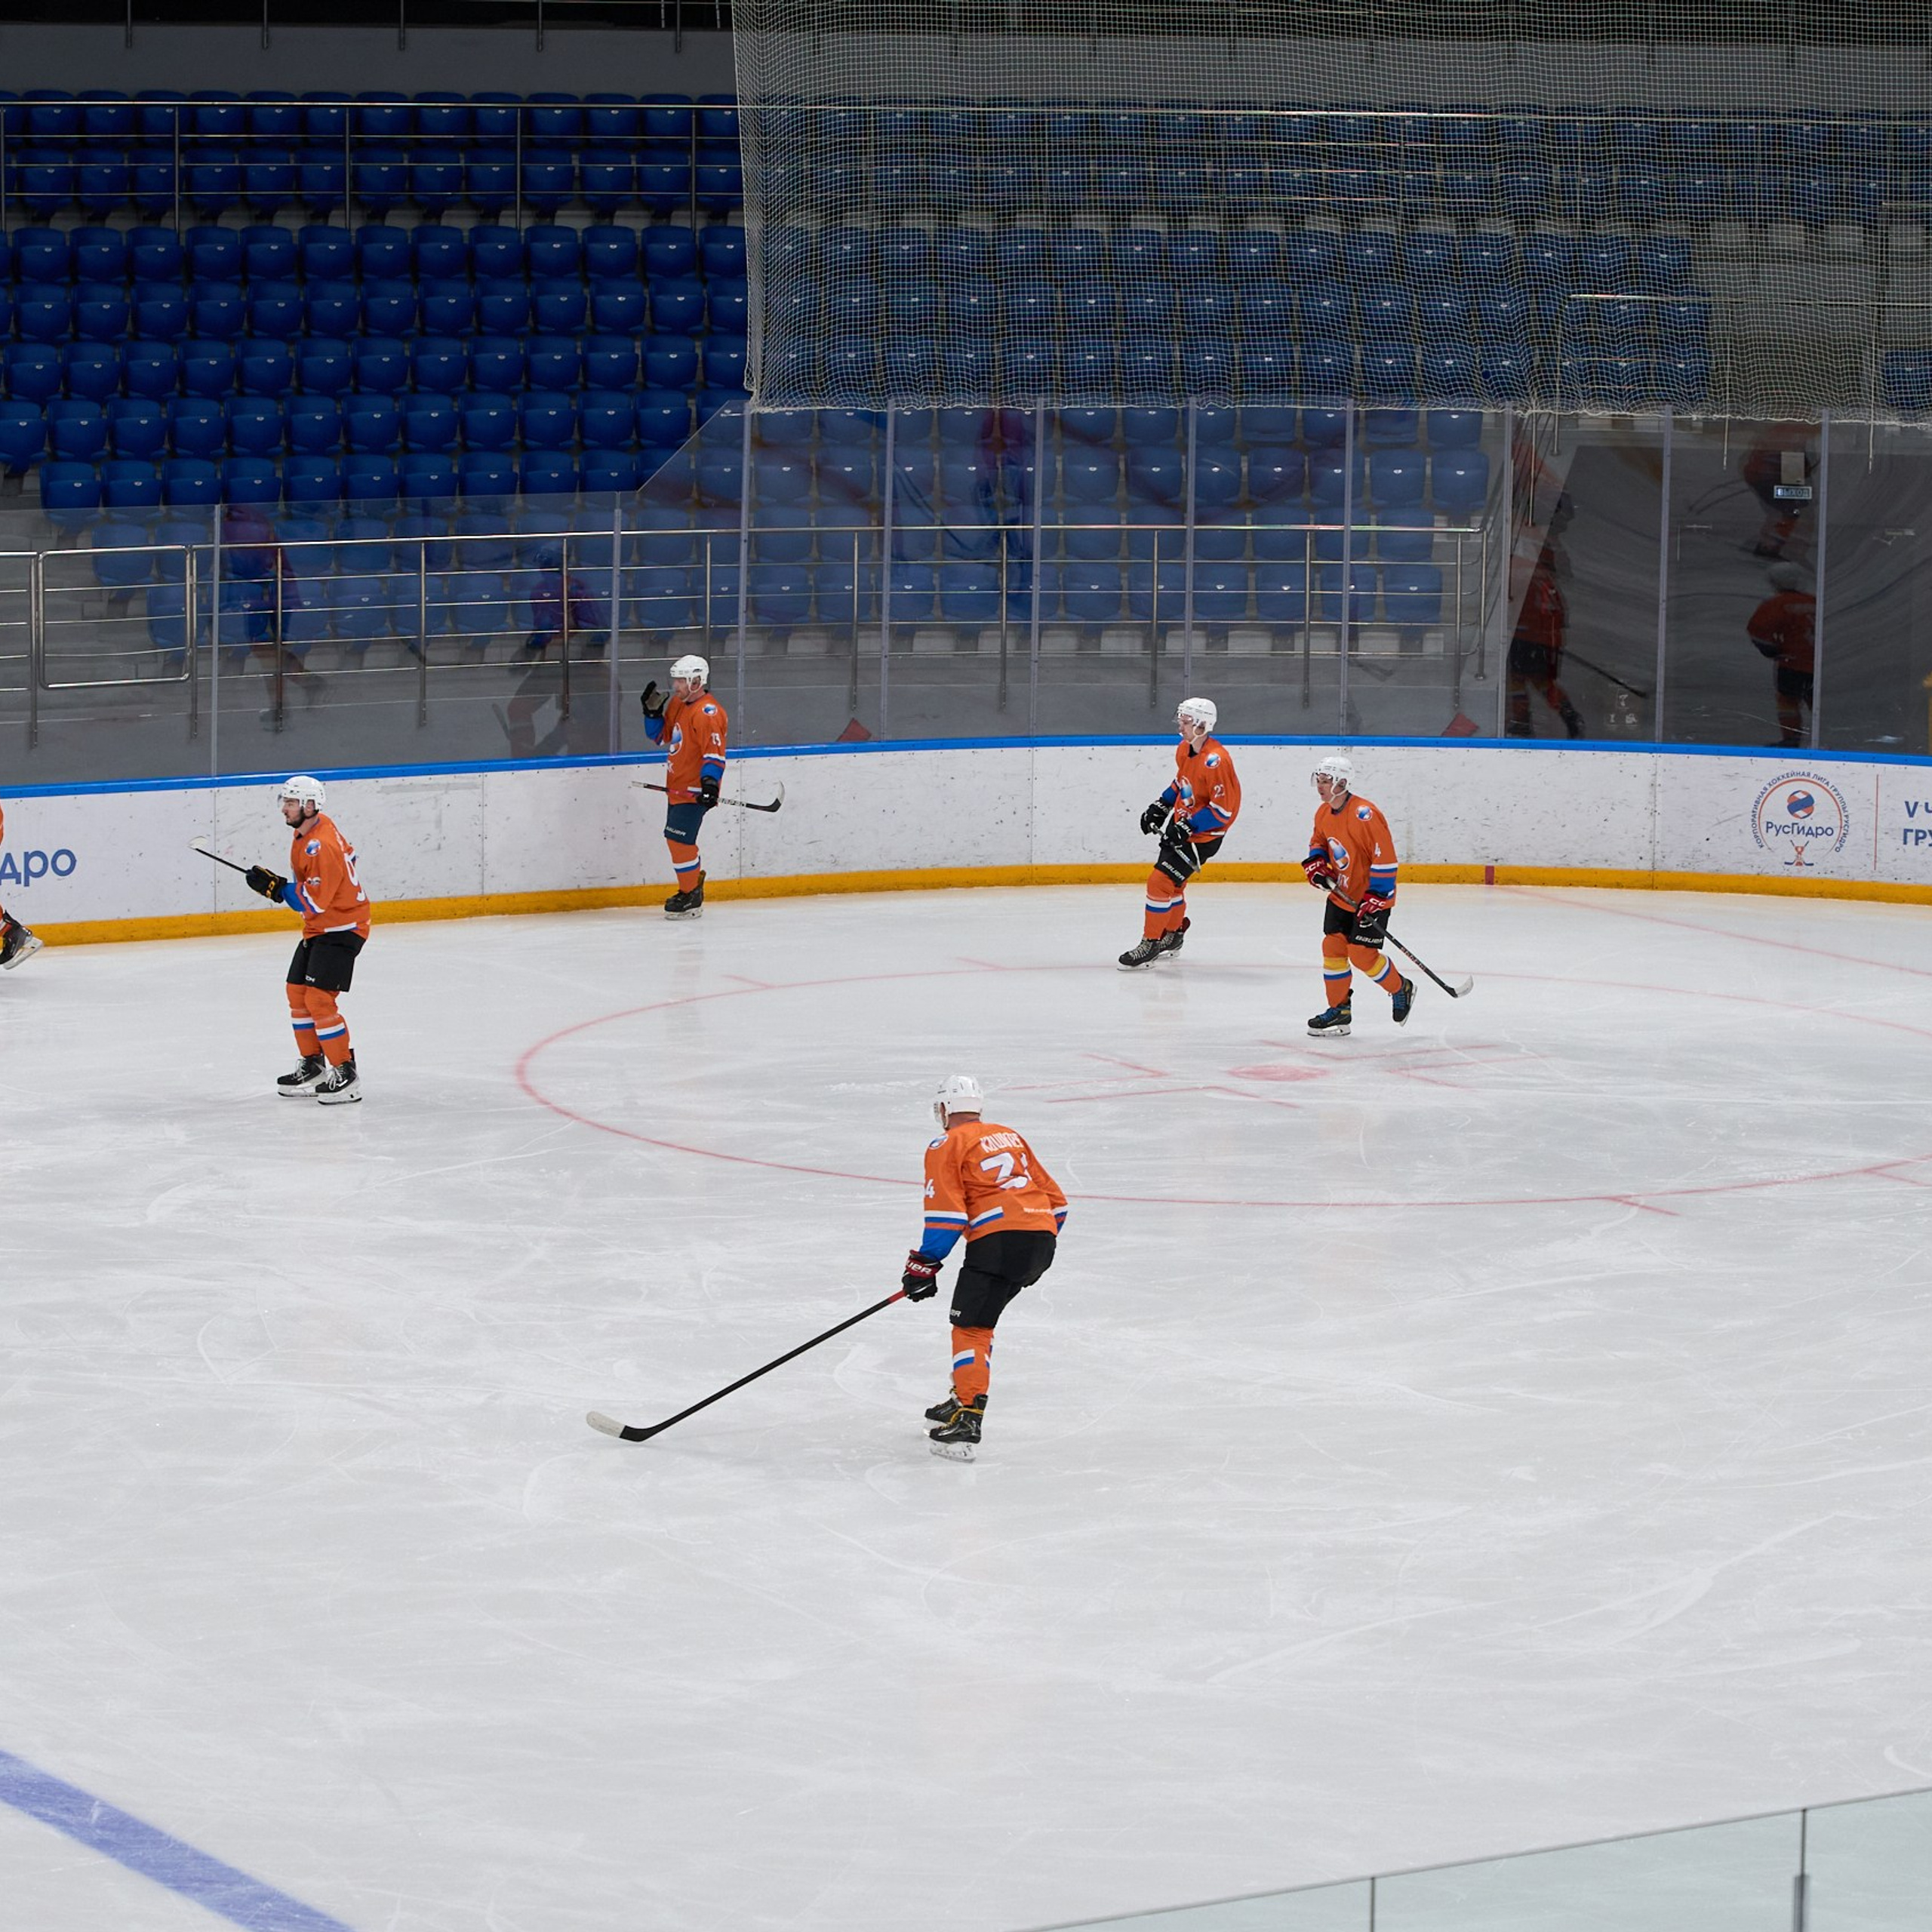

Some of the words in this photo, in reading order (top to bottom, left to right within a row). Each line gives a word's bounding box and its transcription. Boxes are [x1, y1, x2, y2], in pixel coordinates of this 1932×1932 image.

[1777, 488, 1809, 497] ВЫХОД
[1767, 771, 1811, 789] ХОККЕЙНАЯ
[1812, 774, 1830, 787] ЛИГА
[1829, 785, 1848, 814] ГРУППЫ
[1751, 786, 1768, 849] КОРПОРАТИВНАЯ
[1766, 821, 1834, 838] РусГидро
[1835, 814, 1850, 853] РУСГИДРО
[1374, 842, 1382, 857] 4
